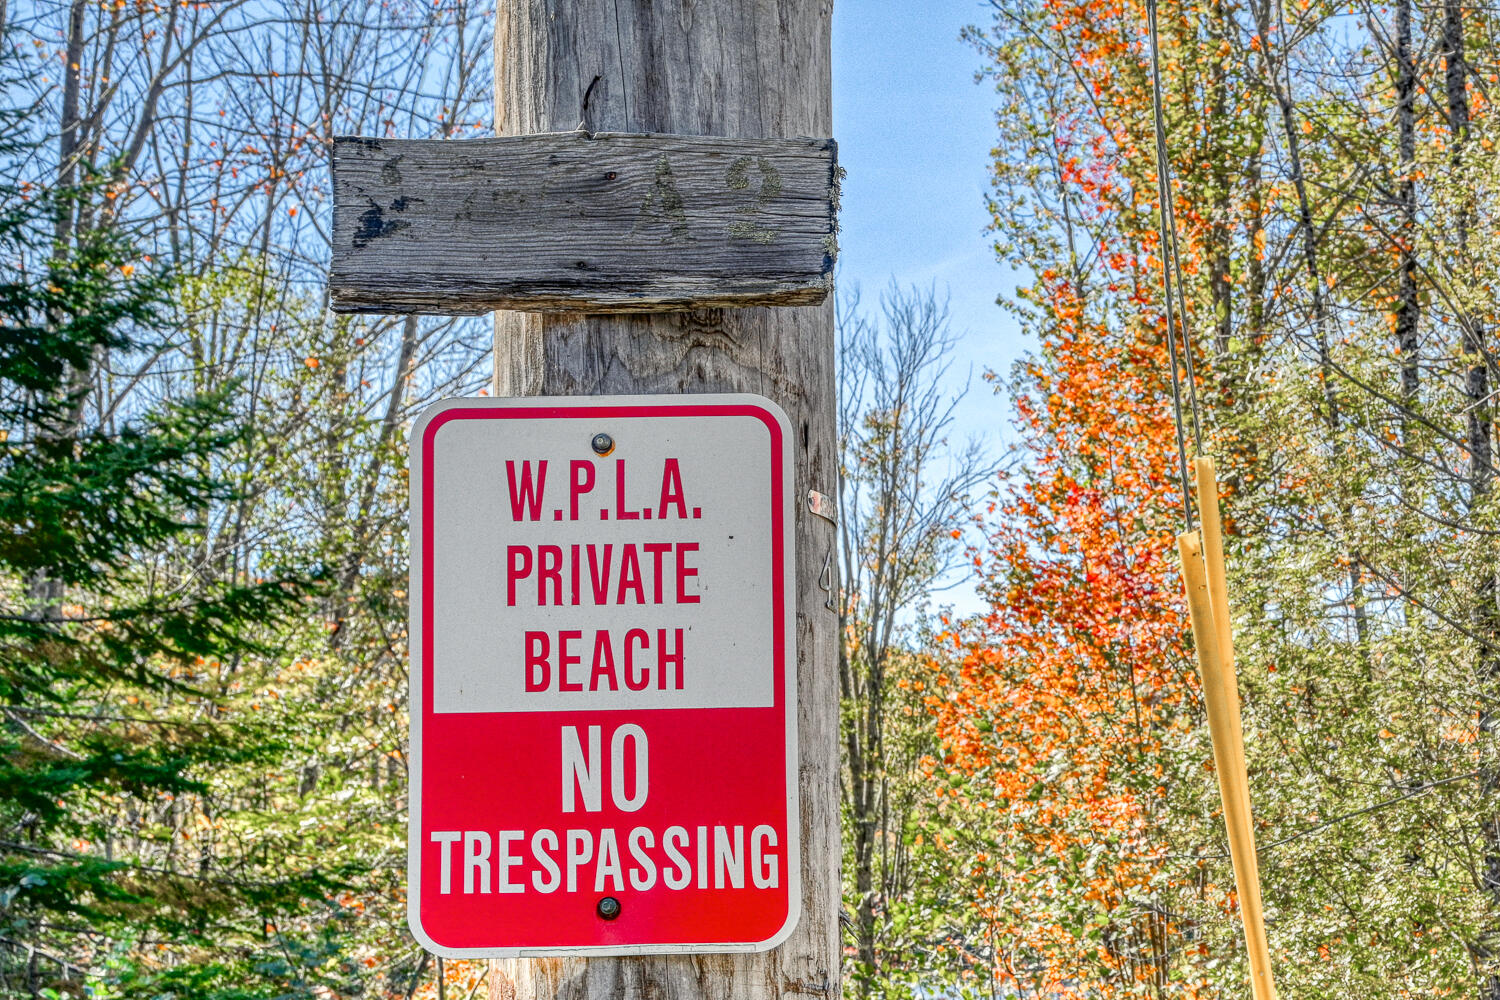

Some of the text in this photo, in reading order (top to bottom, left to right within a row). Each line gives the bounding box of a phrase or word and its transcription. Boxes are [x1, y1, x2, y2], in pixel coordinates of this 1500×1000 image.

[505, 458, 702, 522] W.P.L.A.
[506, 542, 701, 607] PRIVATE
[524, 628, 684, 693] BEACH
[561, 723, 649, 813] NO
[430, 825, 779, 895] TRESPASSING
